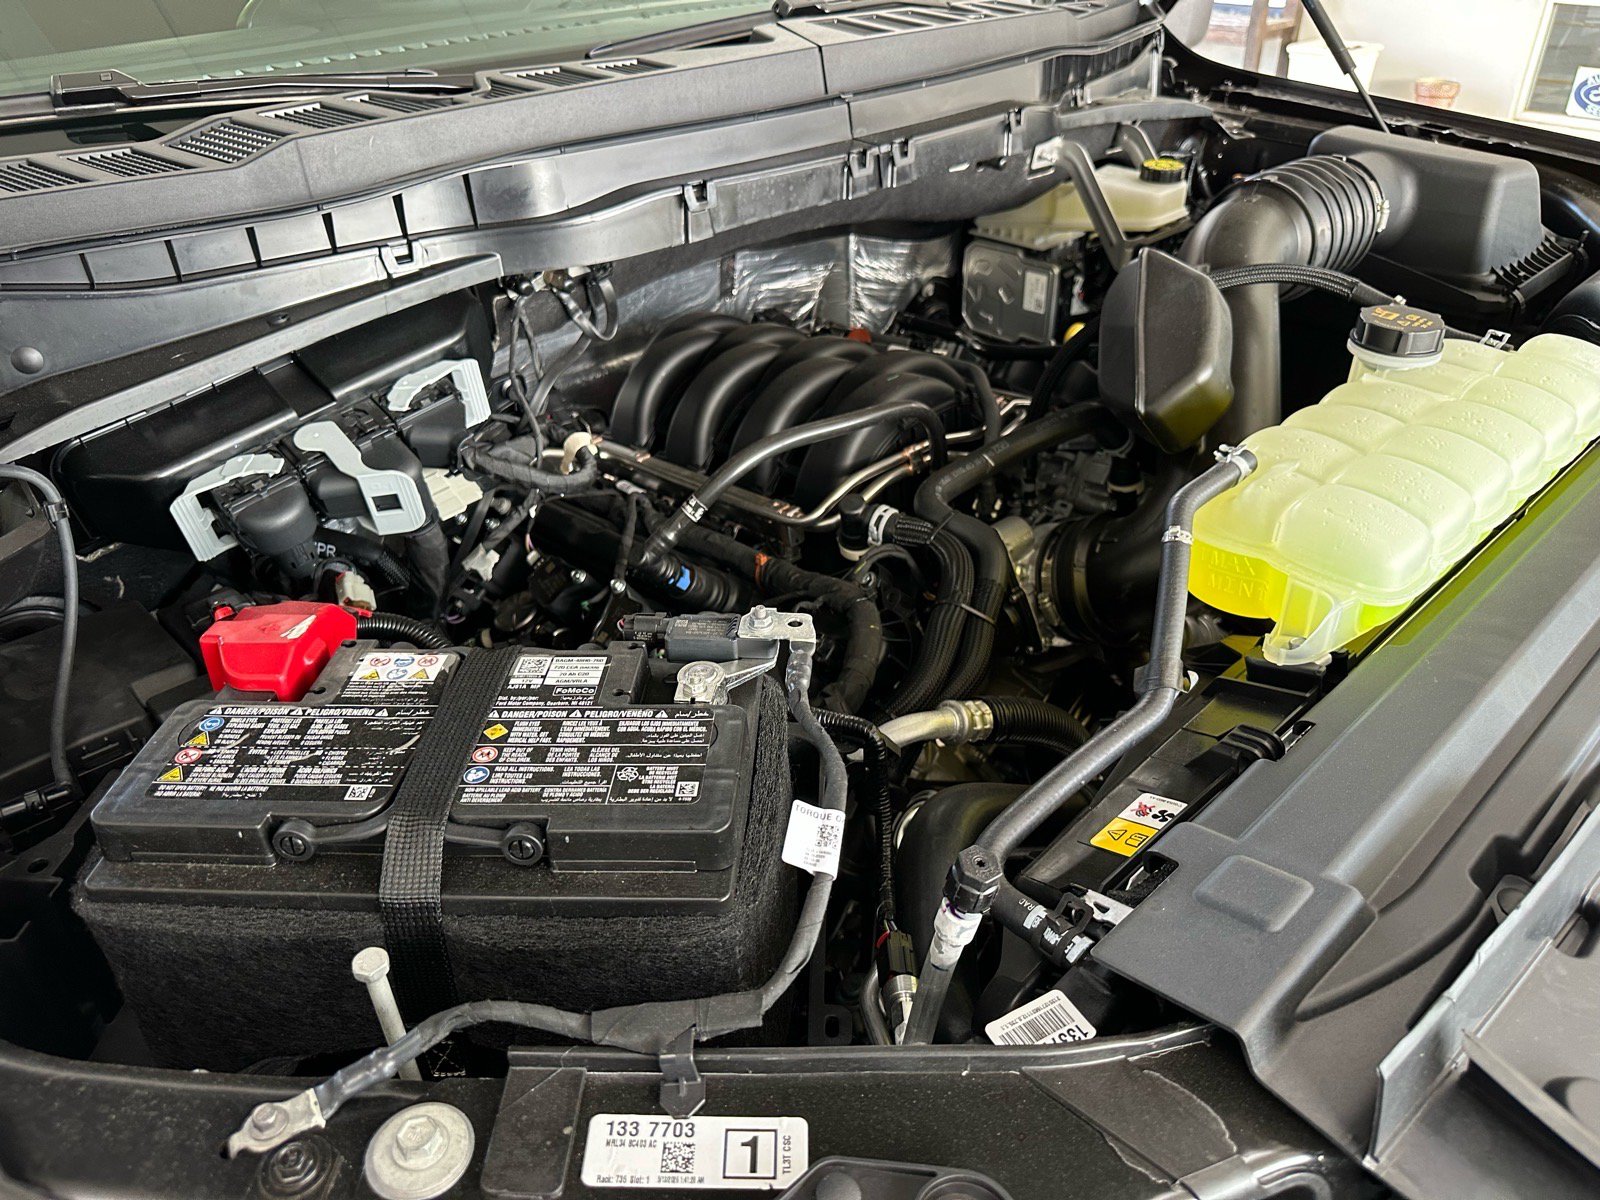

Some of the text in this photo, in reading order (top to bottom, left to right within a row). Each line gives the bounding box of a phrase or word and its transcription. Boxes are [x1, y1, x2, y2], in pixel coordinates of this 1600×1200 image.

[314, 542, 337, 557] PR
[501, 710, 568, 718] DANGER/POISON
[795, 804, 832, 821] TORQUE
[606, 1120, 696, 1138] 133 7703
[740, 1135, 760, 1174] 1
[782, 1134, 792, 1175] TL3T CSC
[596, 1175, 613, 1184] Rack:
[615, 1175, 628, 1184] 735
